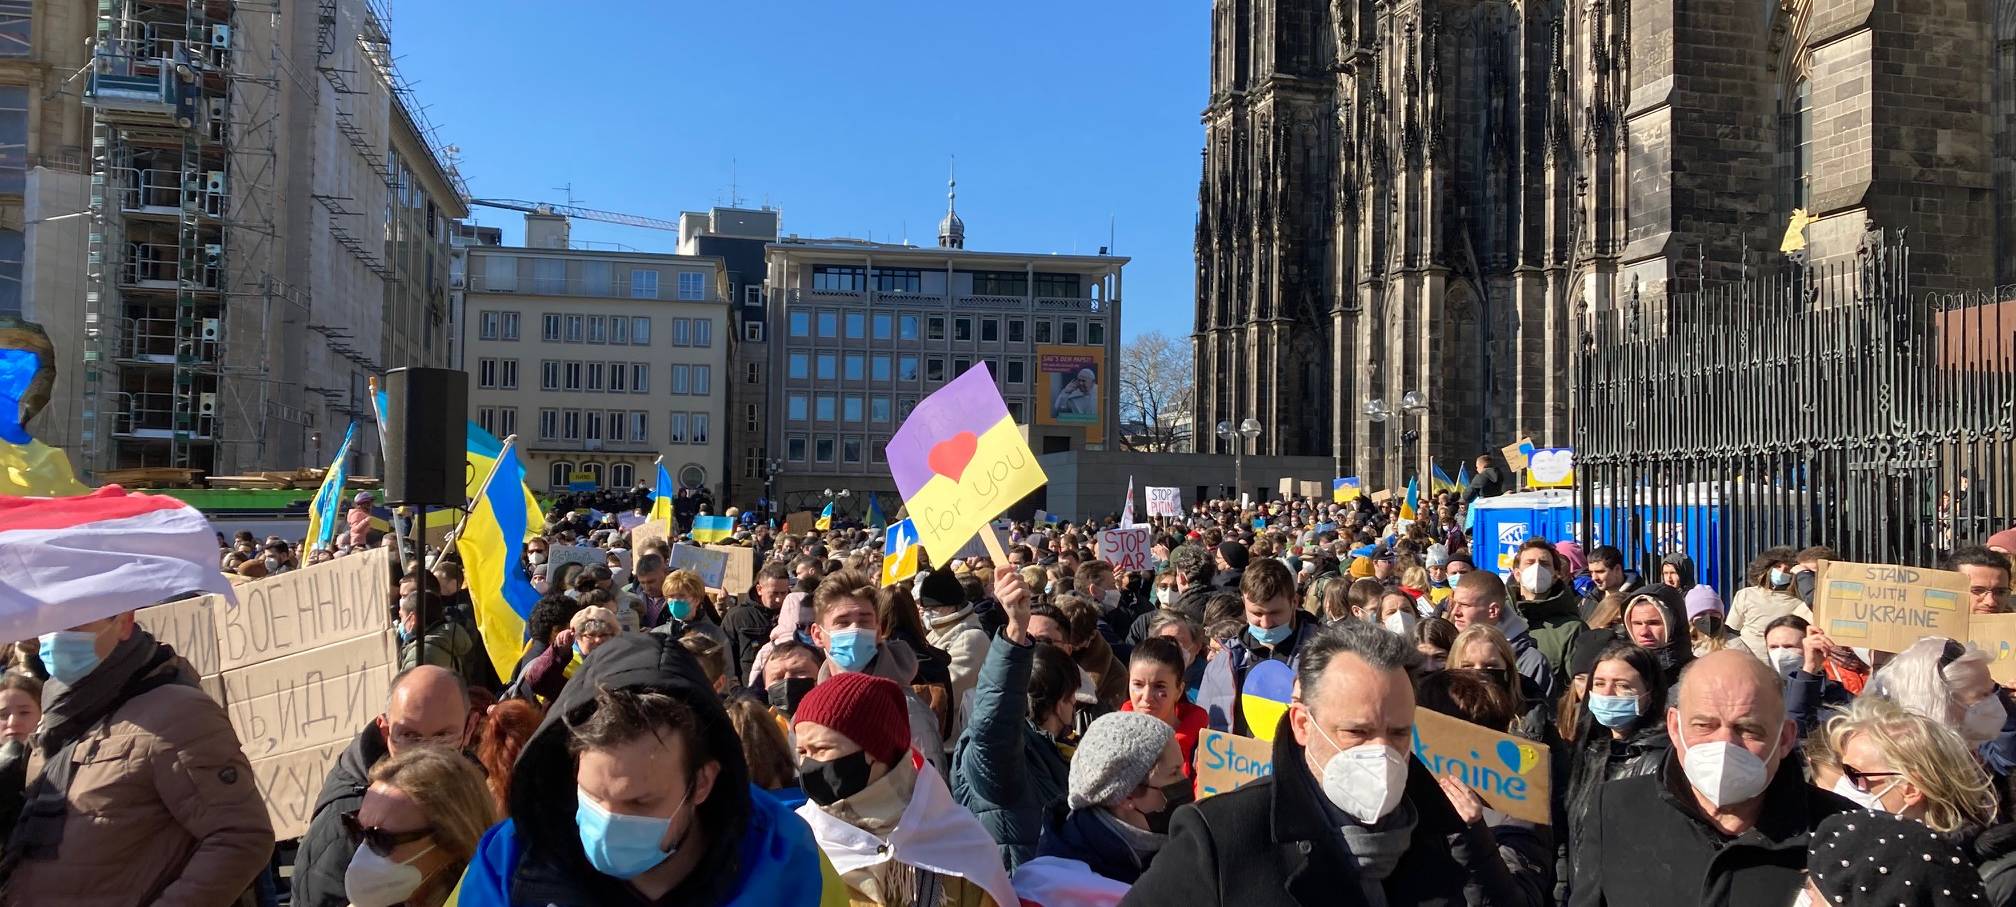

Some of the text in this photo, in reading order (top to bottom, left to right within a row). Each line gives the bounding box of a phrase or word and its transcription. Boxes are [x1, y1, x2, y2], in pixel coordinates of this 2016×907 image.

[925, 446, 1026, 542] for you
[1151, 488, 1172, 501] STOP
[1151, 501, 1174, 513] PUTIN
[1104, 530, 1147, 553] STOP
[1865, 567, 1920, 584] STAND
[1868, 586, 1907, 602] WITH
[224, 555, 388, 662] ВОЕННЫЙ
[1854, 602, 1940, 628] UKRAINE
[1412, 722, 1528, 801] kraine
